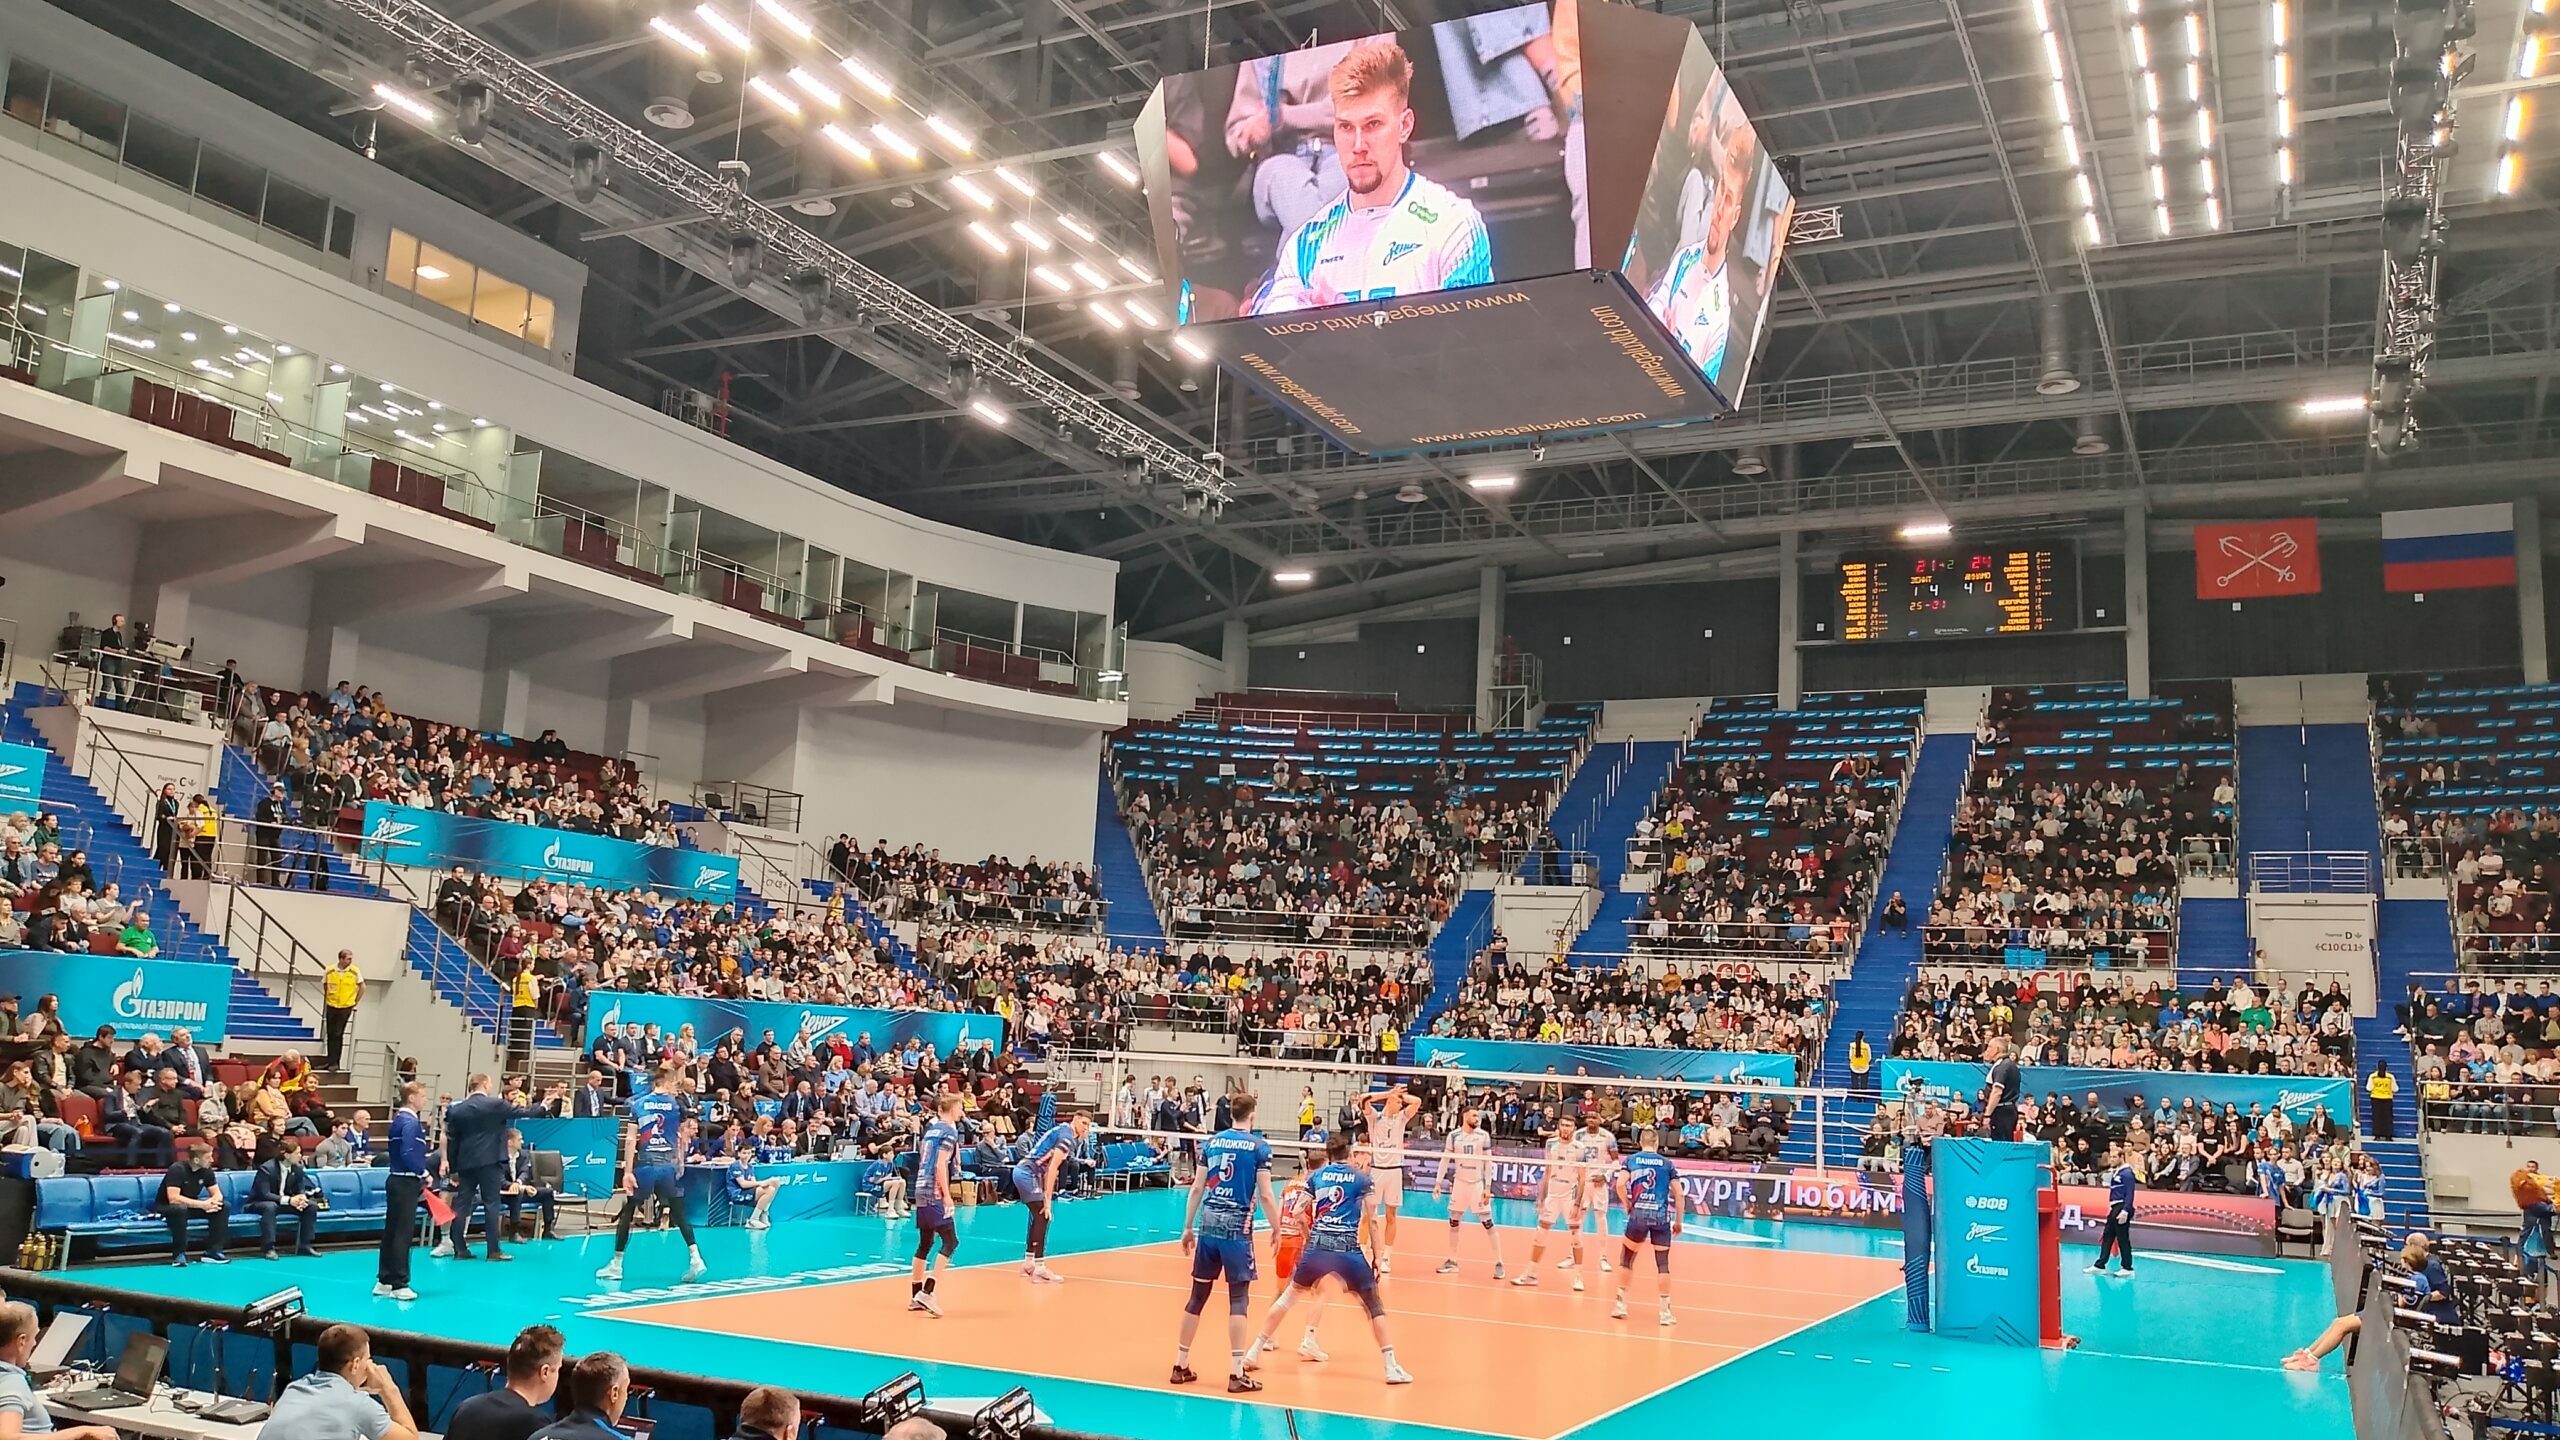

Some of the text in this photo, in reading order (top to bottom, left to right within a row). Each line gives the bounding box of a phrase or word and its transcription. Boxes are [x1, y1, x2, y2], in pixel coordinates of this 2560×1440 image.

[1240, 353, 1361, 434] www.megaluxltd.com
[1411, 410, 1647, 445] www.megaluxltd.com
[1929, 584, 1939, 597] 4
[1963, 581, 1993, 595] 4 0
[2345, 931, 2353, 940] D
[2320, 943, 2358, 952] C10 C11
[1210, 1138, 1256, 1152] САПОЖКОВ
[1219, 1152, 1237, 1182] 5
[1635, 1157, 1664, 1167] ПАНКОВ
[1321, 1171, 1356, 1184] БОГДАН
[1643, 1167, 1656, 1190] 3
[1977, 1196, 2008, 1211] ВФВ
